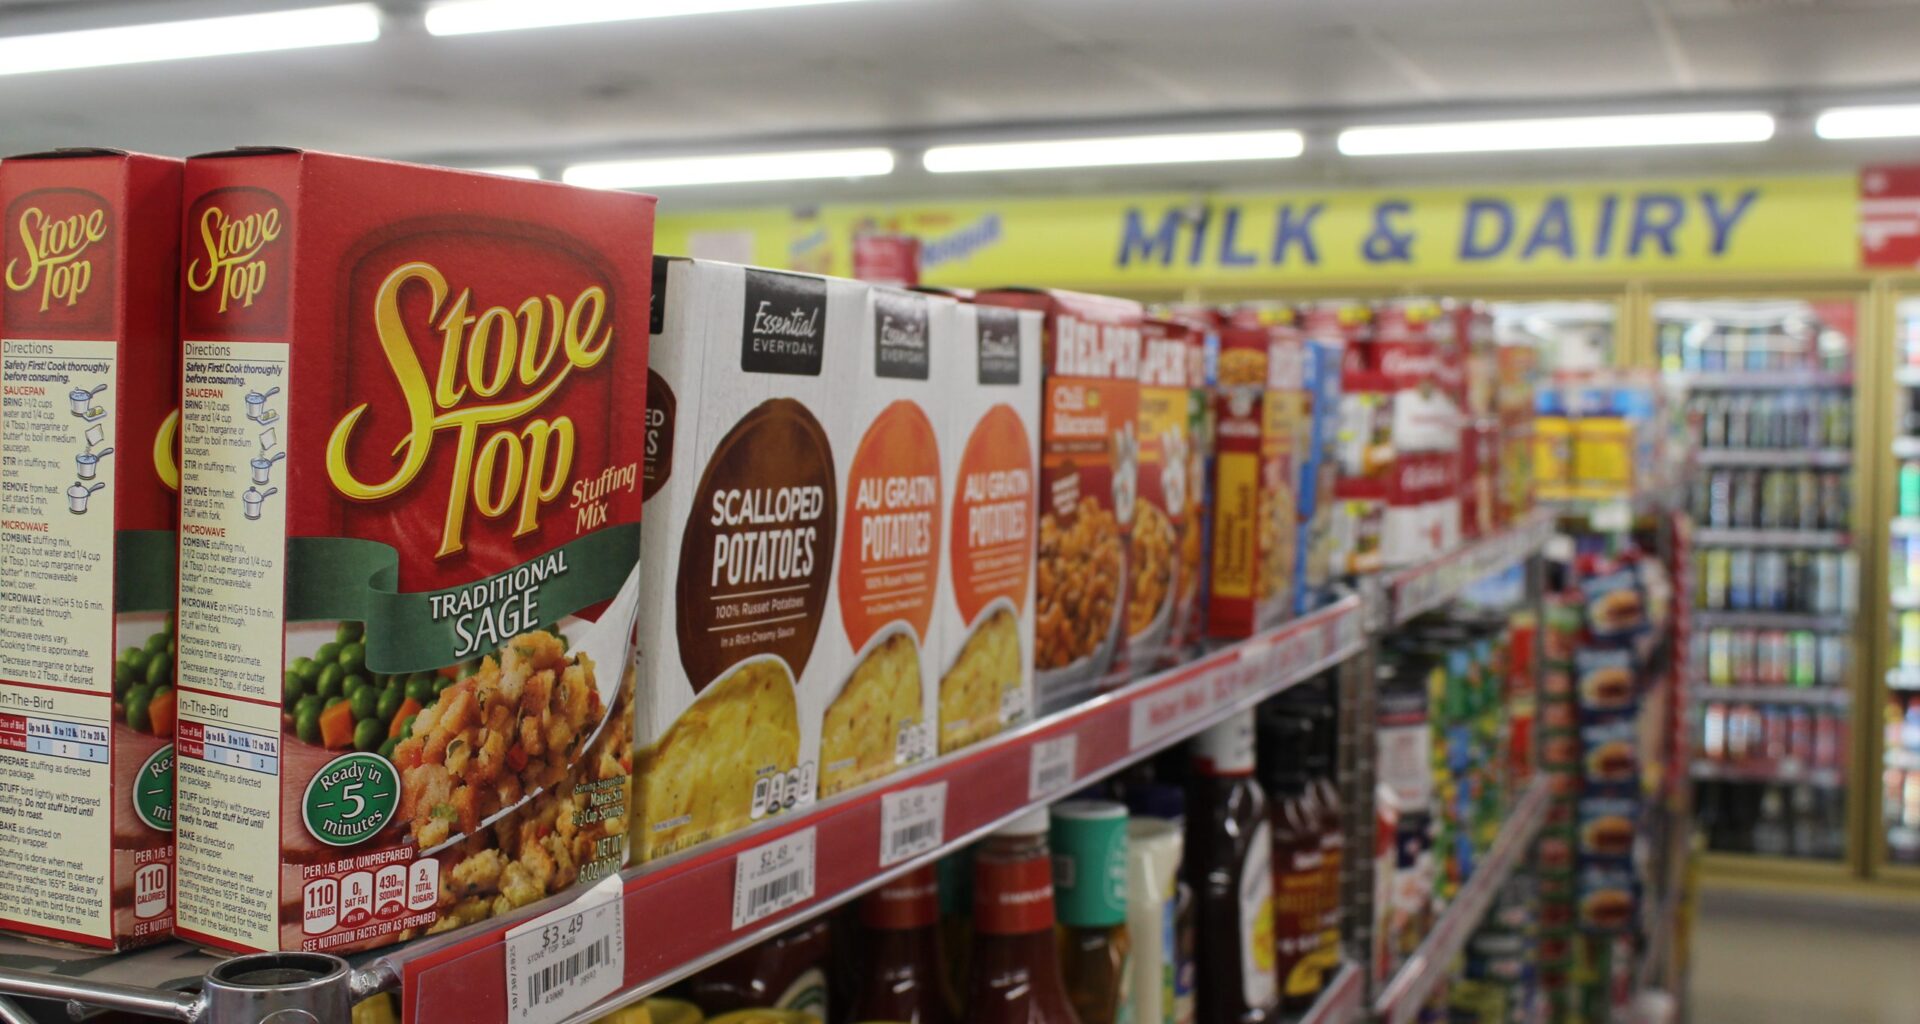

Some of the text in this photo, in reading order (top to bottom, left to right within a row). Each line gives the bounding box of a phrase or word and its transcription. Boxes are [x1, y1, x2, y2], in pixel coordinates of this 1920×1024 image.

[1116, 187, 1761, 270] MILK & DAIRY
[5, 207, 107, 291] Stove
[188, 207, 281, 291] Stove
[38, 255, 92, 312] Top
[217, 256, 267, 313] Top
[753, 300, 819, 338] Essential
[4, 342, 53, 354] Directions
[185, 343, 231, 356] Directions
[1055, 315, 1141, 379] HELPER
[4, 360, 110, 374] Safety First! Cook thoroughly
[4, 372, 70, 384] before consuming.
[186, 362, 283, 376] Safety First! Cook thoroughly
[4, 386, 45, 396] SAUCEPAN
[185, 374, 246, 386] before consuming.
[326, 262, 612, 500] Stove
[185, 388, 223, 398] SAUCEPAN
[433, 405, 574, 559] Top
[570, 463, 637, 508] Stuffing
[856, 475, 937, 511] AU GRATIN
[964, 473, 987, 504] AU
[987, 469, 1029, 499] GRATIN
[576, 501, 608, 534] Mix
[711, 486, 824, 527] SCALLOPED
[2, 521, 49, 532] MICROWAVE
[183, 524, 226, 538] MICROWAVE
[969, 501, 1027, 548] POTATOES
[861, 511, 931, 563] POTATOES
[711, 526, 817, 587] POTATOES
[430, 550, 568, 620] TRADITIONAL
[1, 592, 41, 605] MICROWAVE
[43, 596, 50, 605] on
[52, 596, 69, 607] HIGH
[70, 598, 75, 608] 5
[76, 599, 83, 608] to
[715, 596, 805, 620] 100% Russet Potatoes
[455, 585, 540, 657] SAGE
[735, 632, 750, 647] Rich
[752, 630, 776, 645] Creamy
[0, 691, 54, 710] In-The-Bird
[179, 698, 229, 718] In-The-Bird
[0, 756, 91, 777] PREPARE stuffing as directed
[179, 762, 262, 788] PREPARE stuffing as directed
[320, 761, 382, 792] Ready in
[0, 782, 101, 807] STUFF bird lightly with prepared
[341, 782, 366, 819] 5
[591, 791, 612, 807] Makes
[202, 808, 264, 829] Do not stuff bird until
[323, 809, 383, 835] minutes
[585, 808, 598, 824] Cup
[599, 804, 624, 820] Servings
[179, 829, 195, 841] BAKE
[203, 836, 226, 849] directed
[597, 834, 623, 857] NET WT
[135, 850, 152, 863] PER
[154, 847, 166, 858] 1/6
[304, 847, 413, 879] PER 1/6 BOX (UNPREPARED)
[140, 869, 164, 893] 110
[415, 882, 432, 893] TOTAL
[137, 891, 165, 905] CALORIES
[309, 883, 334, 908] 110
[345, 895, 369, 908] SAT FAT
[379, 888, 403, 901] SODIUM
[411, 892, 435, 905] SUGARS
[306, 907, 335, 920] CALORIES
[392, 904, 400, 912] DV
[135, 923, 148, 937] SEE
[303, 910, 437, 953] SEE NUTRITION FACTS FOR AS PREPARED
[542, 913, 584, 949] $3.49
[527, 951, 545, 965] STOVE
